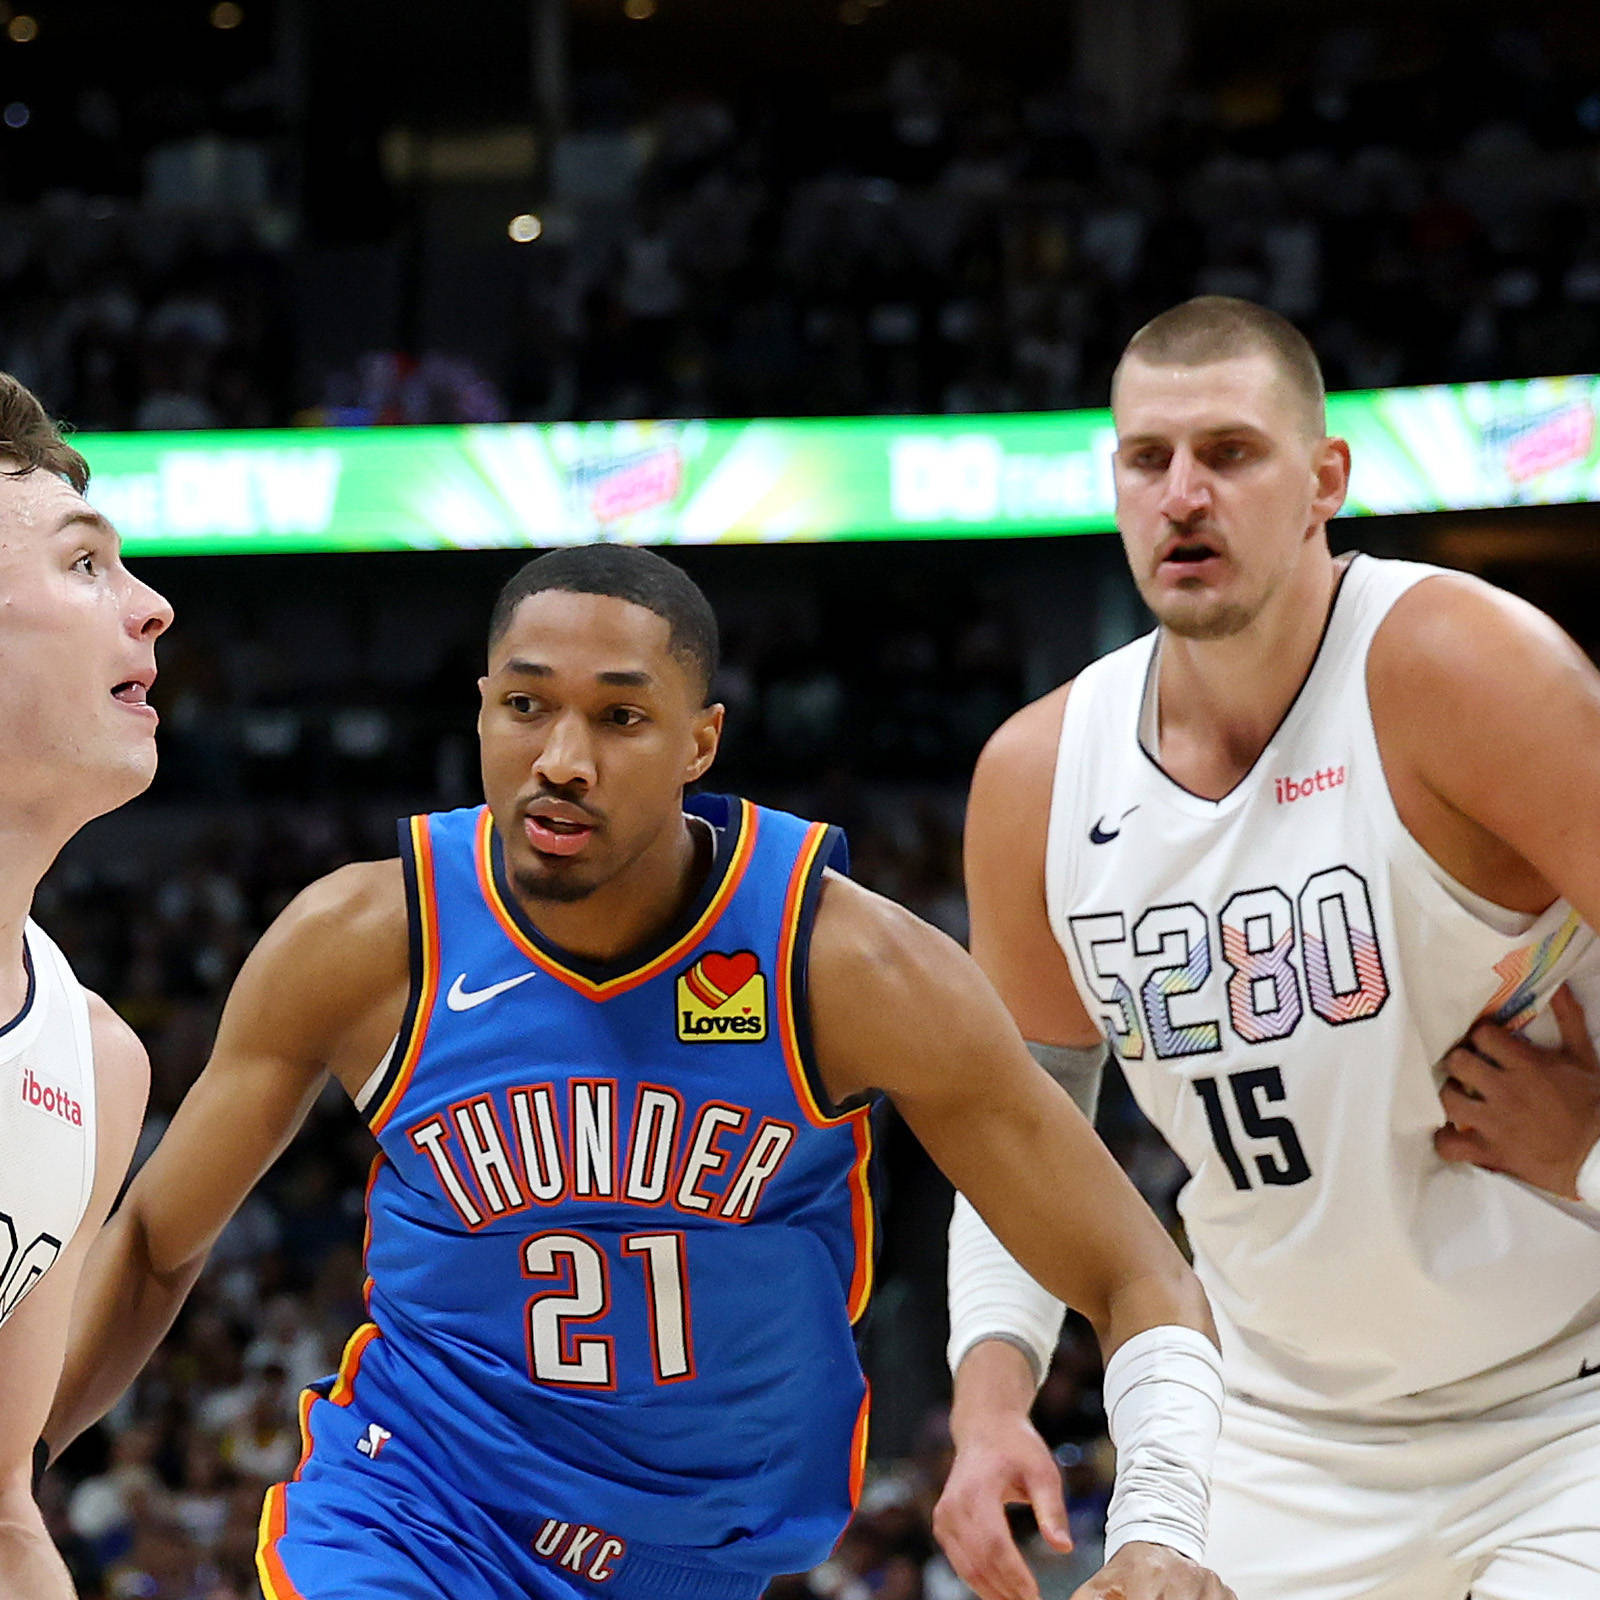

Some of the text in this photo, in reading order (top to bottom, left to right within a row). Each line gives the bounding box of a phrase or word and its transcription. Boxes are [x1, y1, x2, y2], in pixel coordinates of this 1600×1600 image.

[158, 448, 342, 537] DEW
[1275, 765, 1345, 804] ibotta
[1068, 863, 1391, 1061] 5280
[21, 1068, 83, 1127] ibotta
[412, 1077, 798, 1231] THUNDER
[1191, 1064, 1312, 1191] 15
[520, 1229, 698, 1390] 21
